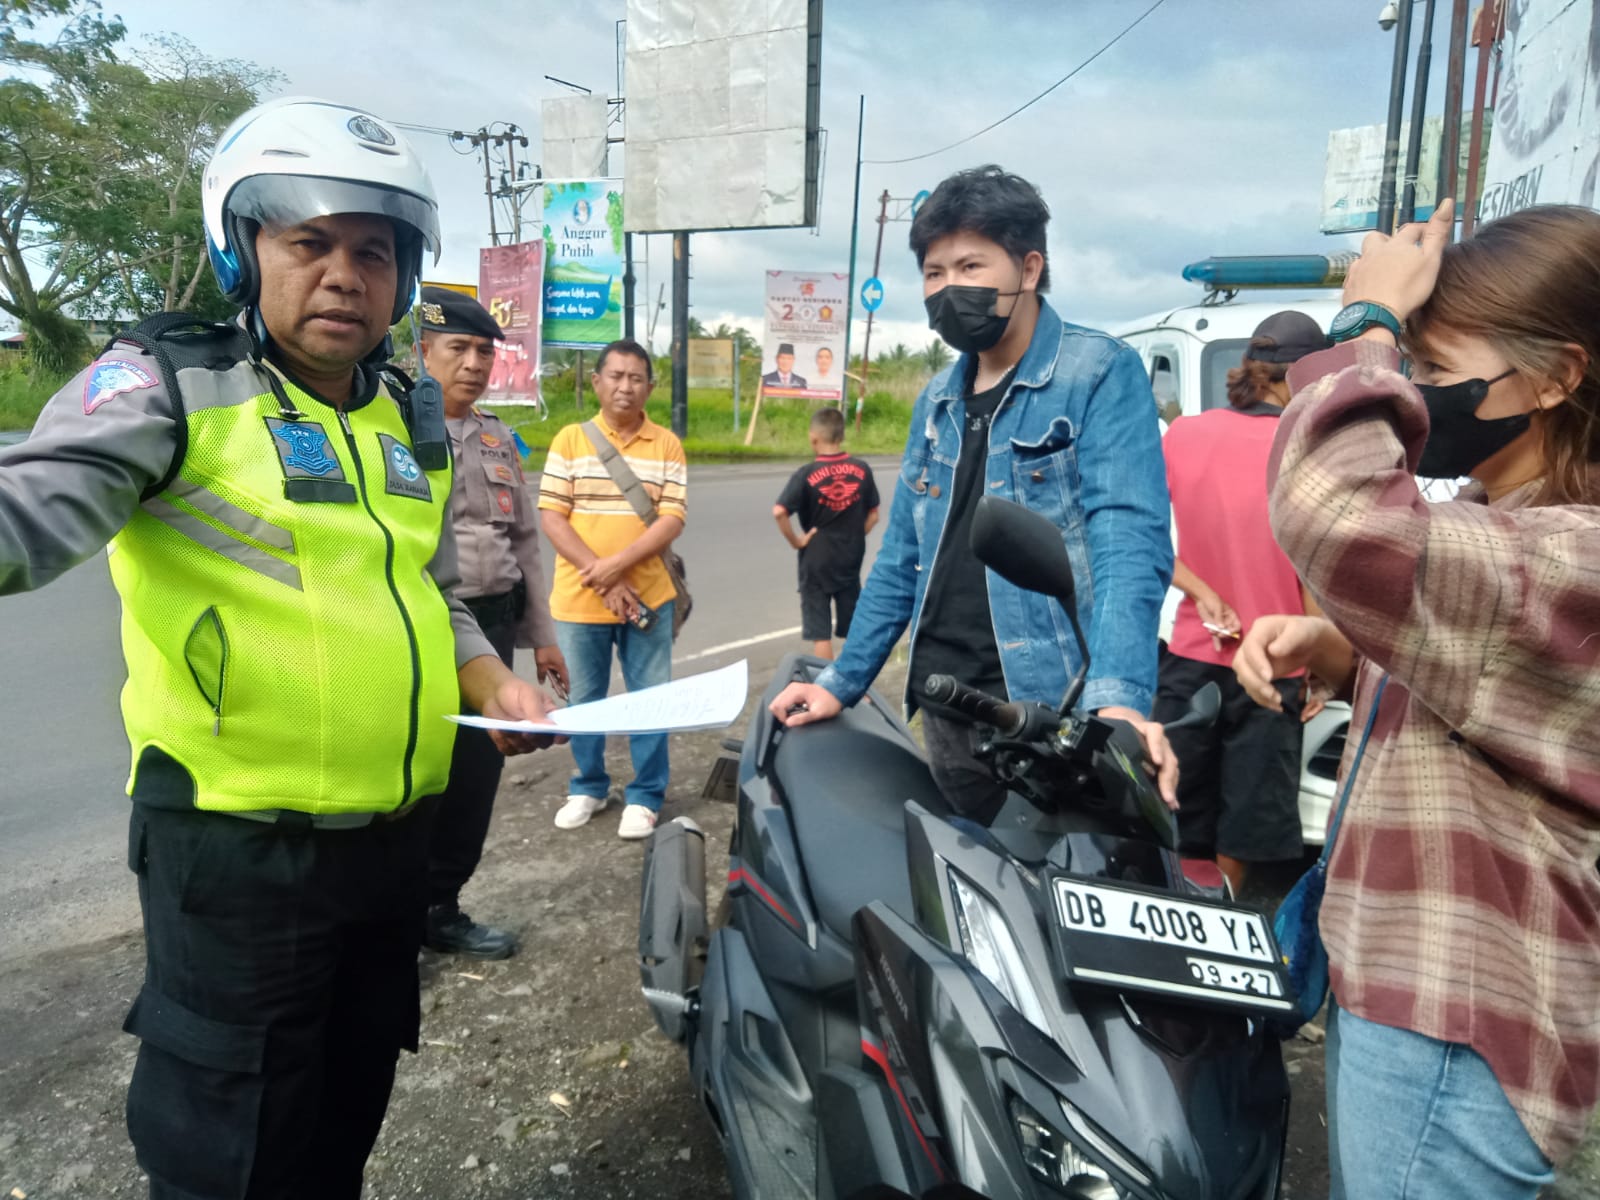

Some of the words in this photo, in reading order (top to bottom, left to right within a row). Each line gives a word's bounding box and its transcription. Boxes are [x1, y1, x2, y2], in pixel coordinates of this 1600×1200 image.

[563, 225, 607, 239] Anggur
[562, 243, 594, 257] Putih
[481, 449, 510, 460] POLRI
[807, 466, 830, 487] MINI
[1064, 889, 1106, 928] DB
[1129, 901, 1207, 944] 4008
[1220, 916, 1266, 956] YA
[879, 954, 909, 1021] HONDA
